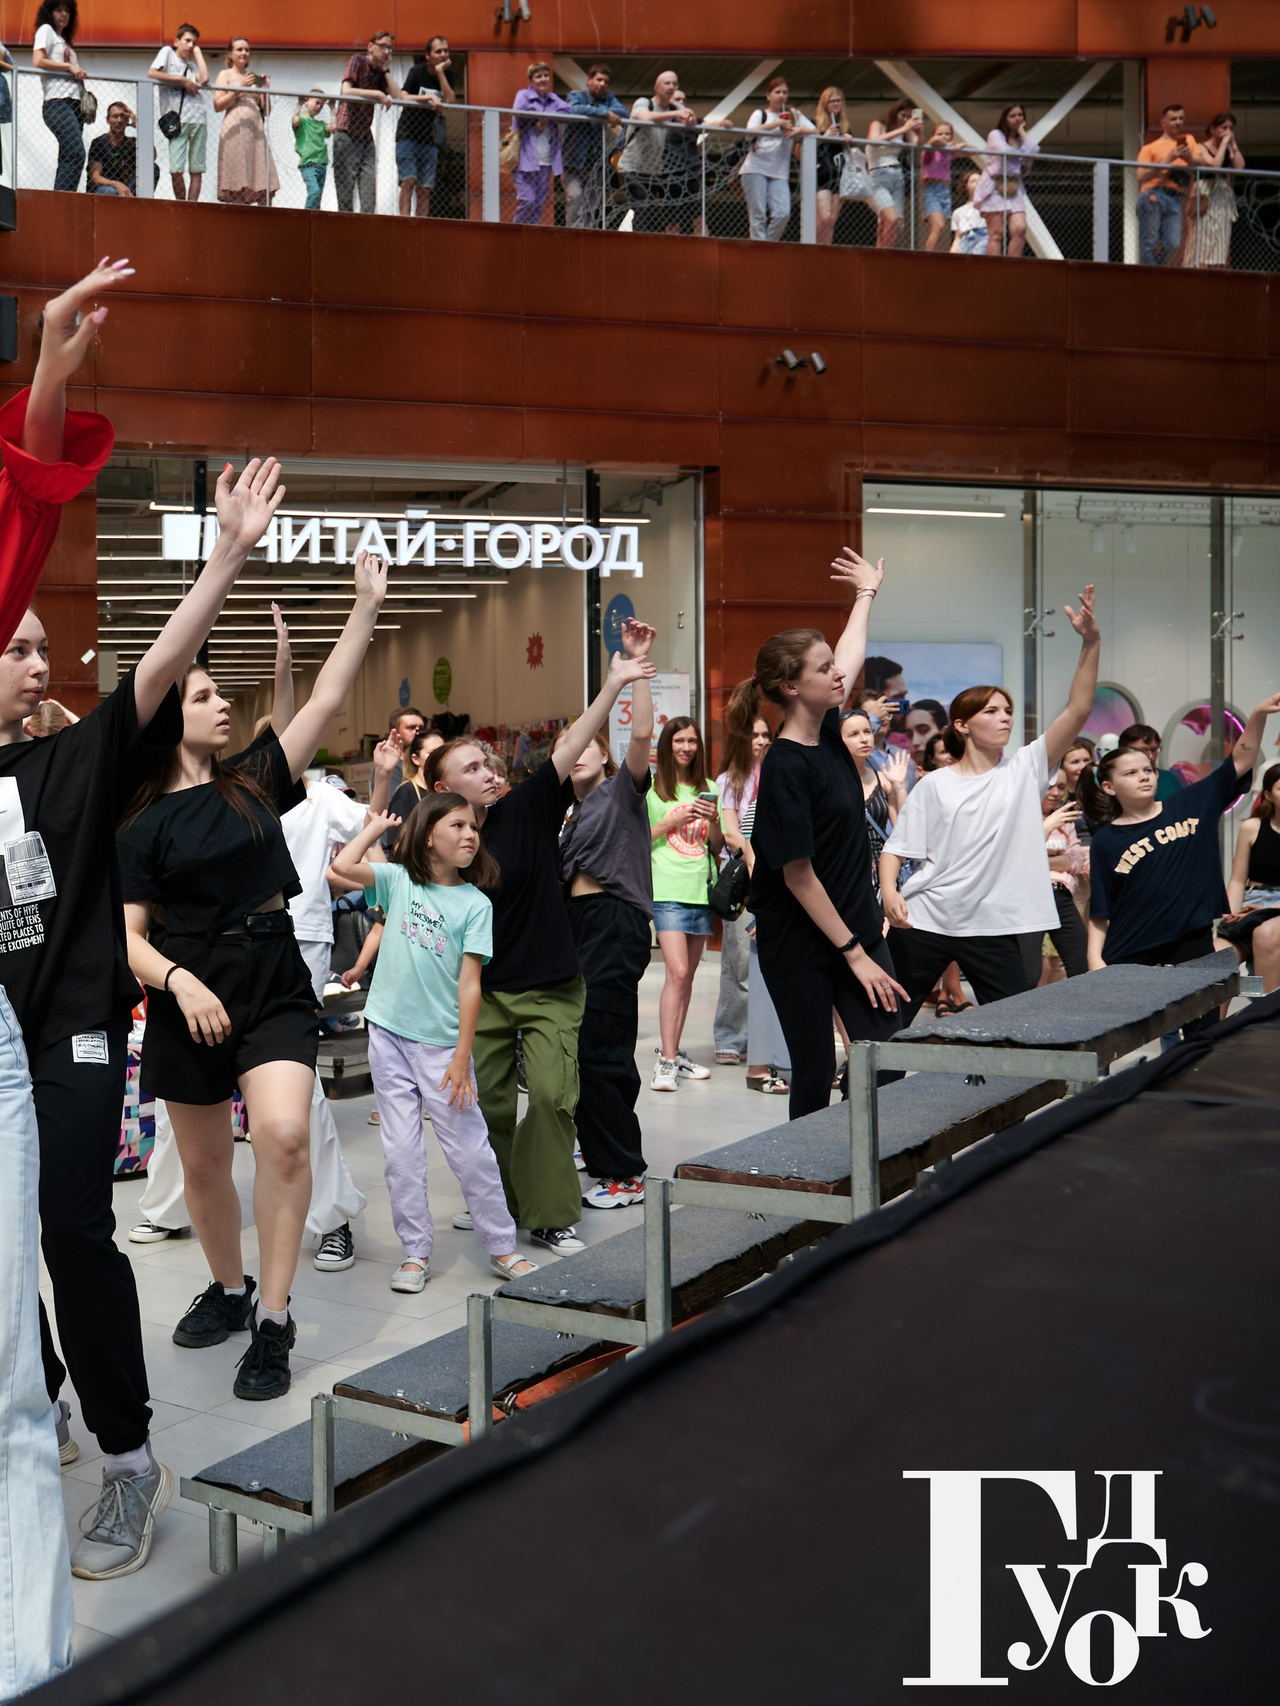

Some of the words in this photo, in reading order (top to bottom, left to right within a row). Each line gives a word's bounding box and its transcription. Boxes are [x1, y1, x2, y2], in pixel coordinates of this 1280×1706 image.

[1114, 836, 1155, 874] WEST
[13, 907, 22, 918] OF
[23, 903, 40, 916] HYPE
[16, 917, 24, 928] OF
[24, 914, 42, 925] TENS
[12, 926, 35, 939] PLACES
[34, 923, 44, 933] TO
[7, 933, 45, 952] EXCITEMENT
